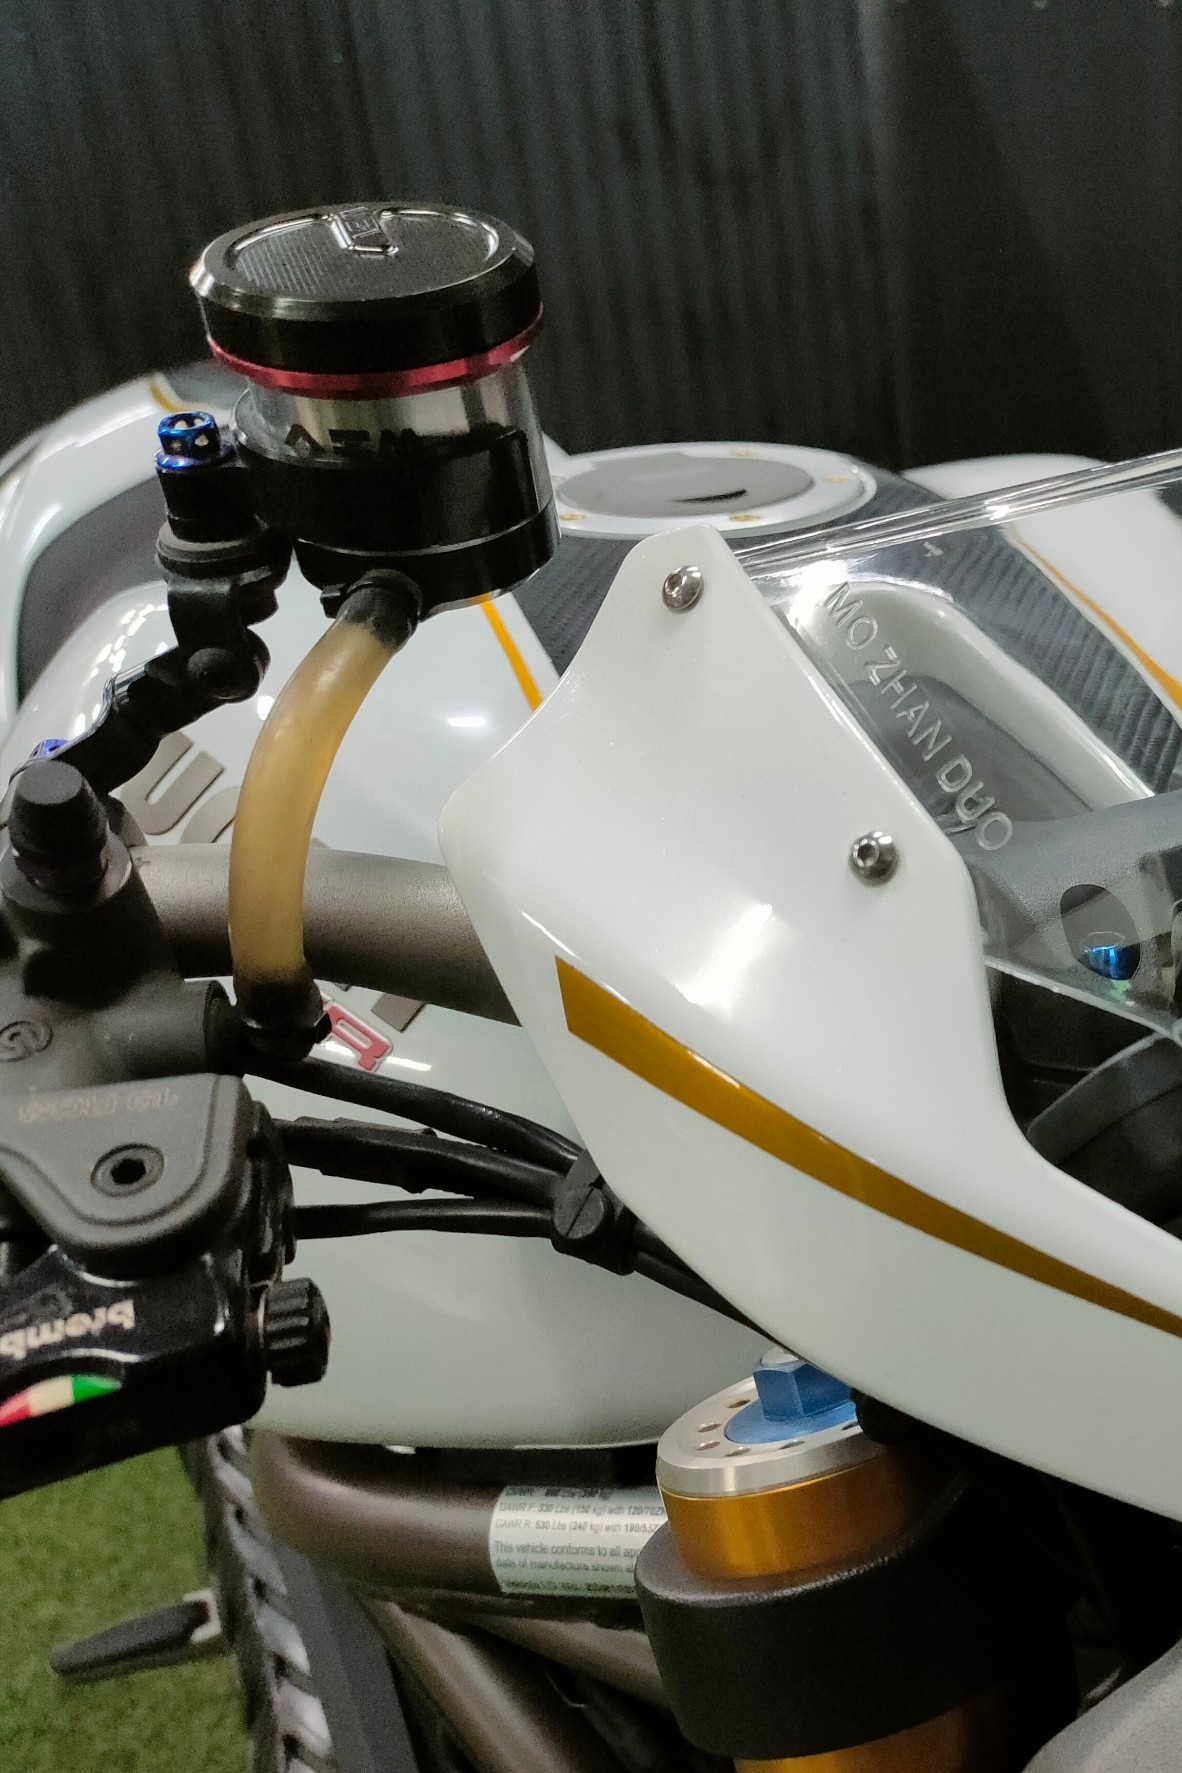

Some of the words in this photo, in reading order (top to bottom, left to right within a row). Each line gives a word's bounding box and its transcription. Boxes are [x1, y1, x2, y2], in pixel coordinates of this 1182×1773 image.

[824, 582, 878, 650] MO
[864, 646, 952, 762] ZHAN
[936, 754, 1013, 851] DUO
[494, 1541, 514, 1553] This
[516, 1542, 549, 1555] vehicle
[551, 1544, 595, 1556] conforms
[597, 1545, 608, 1557] to
[609, 1546, 621, 1557] all
